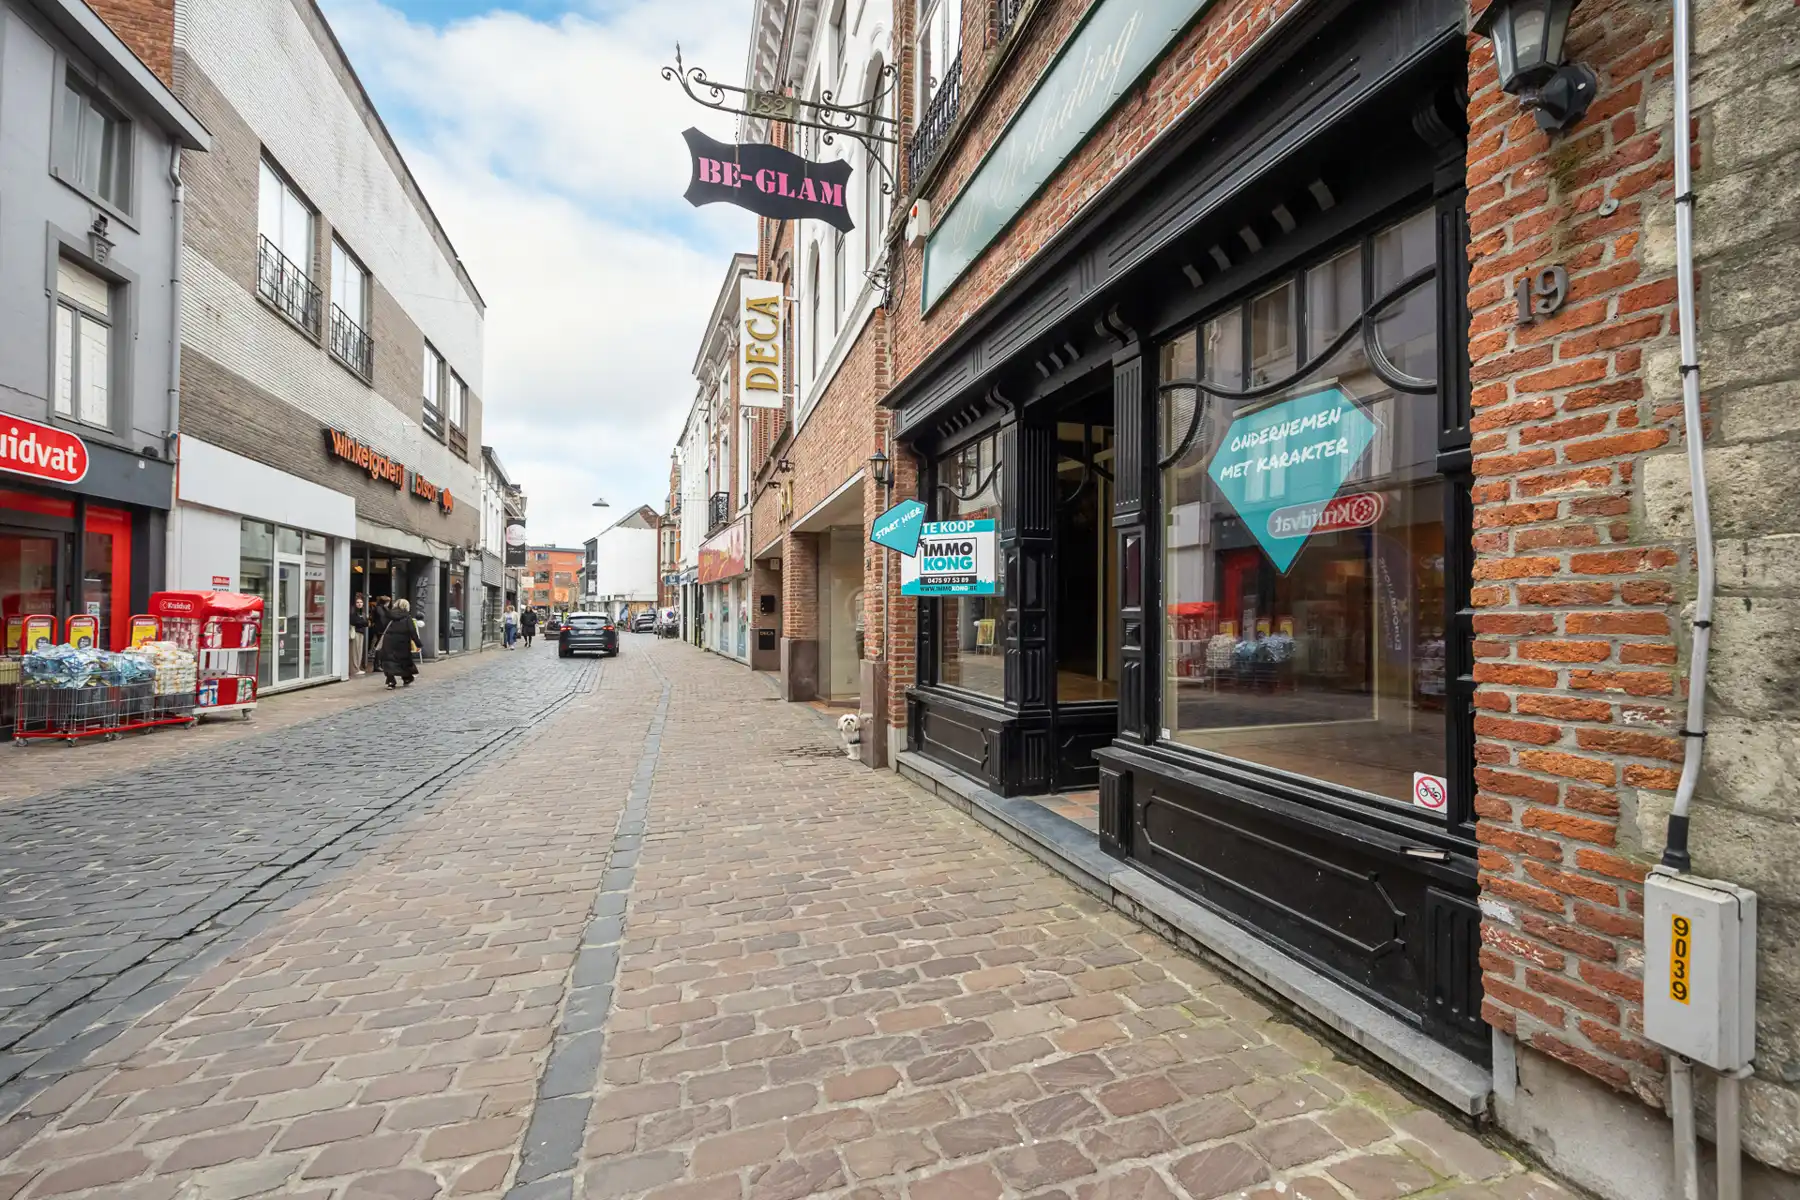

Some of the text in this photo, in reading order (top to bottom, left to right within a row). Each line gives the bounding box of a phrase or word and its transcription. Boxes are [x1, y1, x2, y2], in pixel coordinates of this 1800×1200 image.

[698, 156, 844, 207] BE-GLAM
[1514, 265, 1569, 325] 19
[745, 295, 780, 392] DECA
[1230, 406, 1342, 453] ONDERNEMEN
[1220, 436, 1349, 481] MET KARAKTER
[875, 507, 923, 540] START HIER
[923, 520, 975, 534] TE KOOP
[923, 541, 973, 557] IMMO
[923, 556, 973, 571] KONG
[1673, 917, 1689, 1001] 9039
